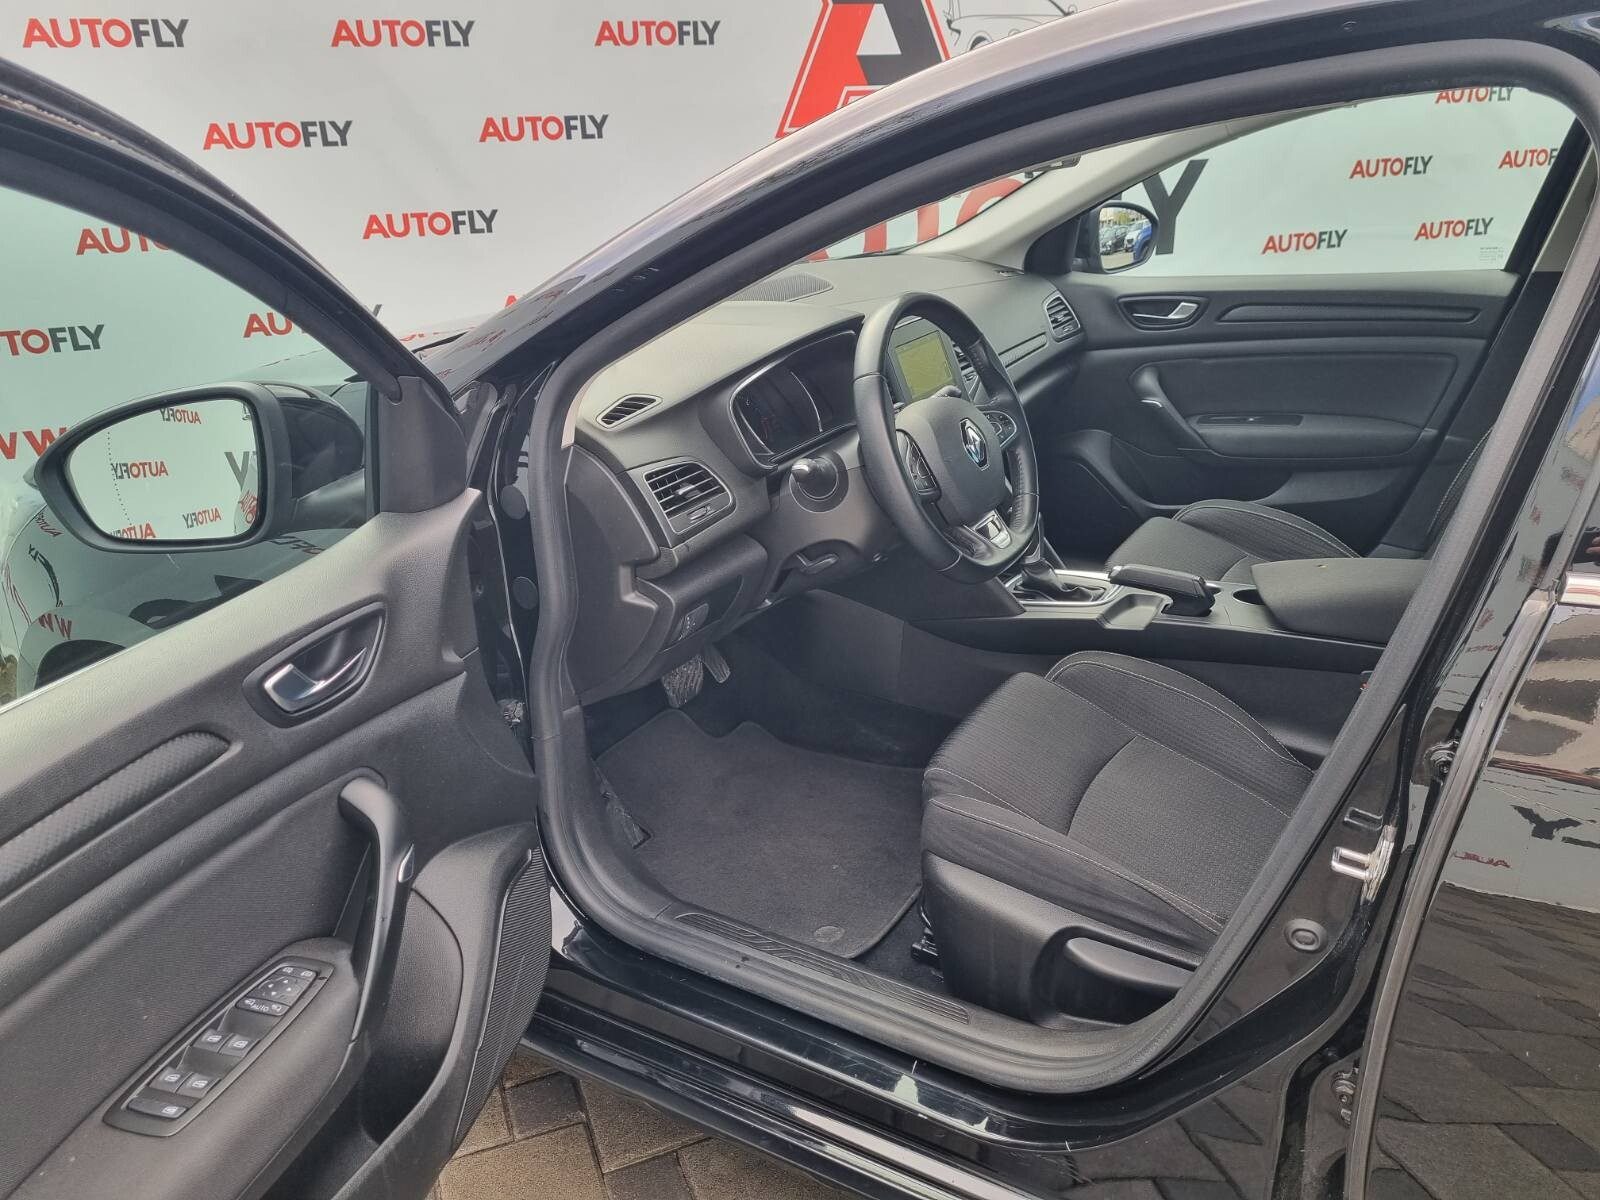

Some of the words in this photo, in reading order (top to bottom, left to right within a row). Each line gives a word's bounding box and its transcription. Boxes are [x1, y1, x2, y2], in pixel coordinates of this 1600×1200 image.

[23, 18, 188, 48] AUTOFLY
[331, 20, 475, 47] AUTOFLY
[595, 20, 721, 46] AUTOFLY
[1435, 87, 1514, 104] AUTOFLY
[203, 121, 352, 150] AUTOFLY
[479, 114, 609, 143] AUTOFLY
[1349, 155, 1433, 179] AUTOFLY
[363, 209, 498, 239] AUTOFLY
[1414, 217, 1494, 241] AUTOFLY
[1261, 229, 1348, 255] AUTOFLY
